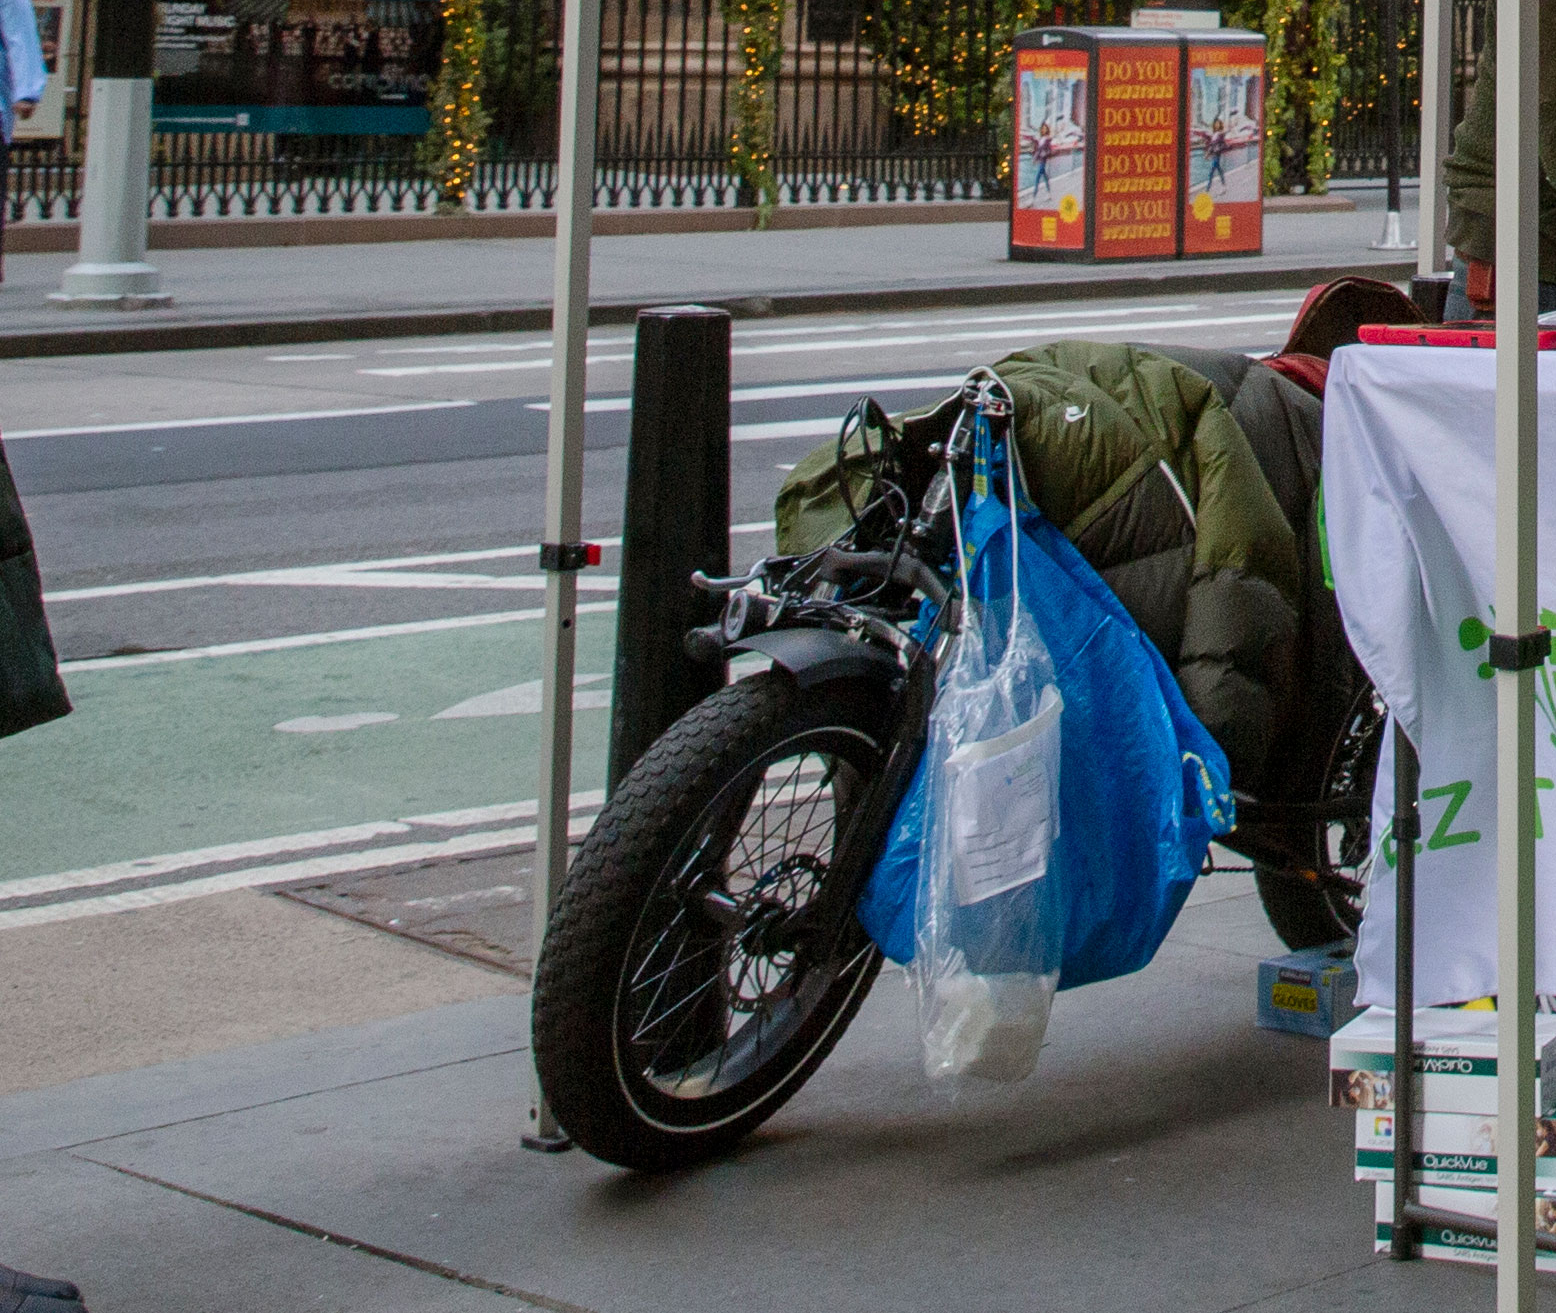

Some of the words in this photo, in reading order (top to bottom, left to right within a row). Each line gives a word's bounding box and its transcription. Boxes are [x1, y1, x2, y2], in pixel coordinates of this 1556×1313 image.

[1105, 61, 1131, 81] DO
[1104, 108, 1131, 127] DO
[1104, 155, 1130, 174] DO
[1103, 201, 1130, 221] DO
[1423, 1153, 1489, 1171] QuickVue
